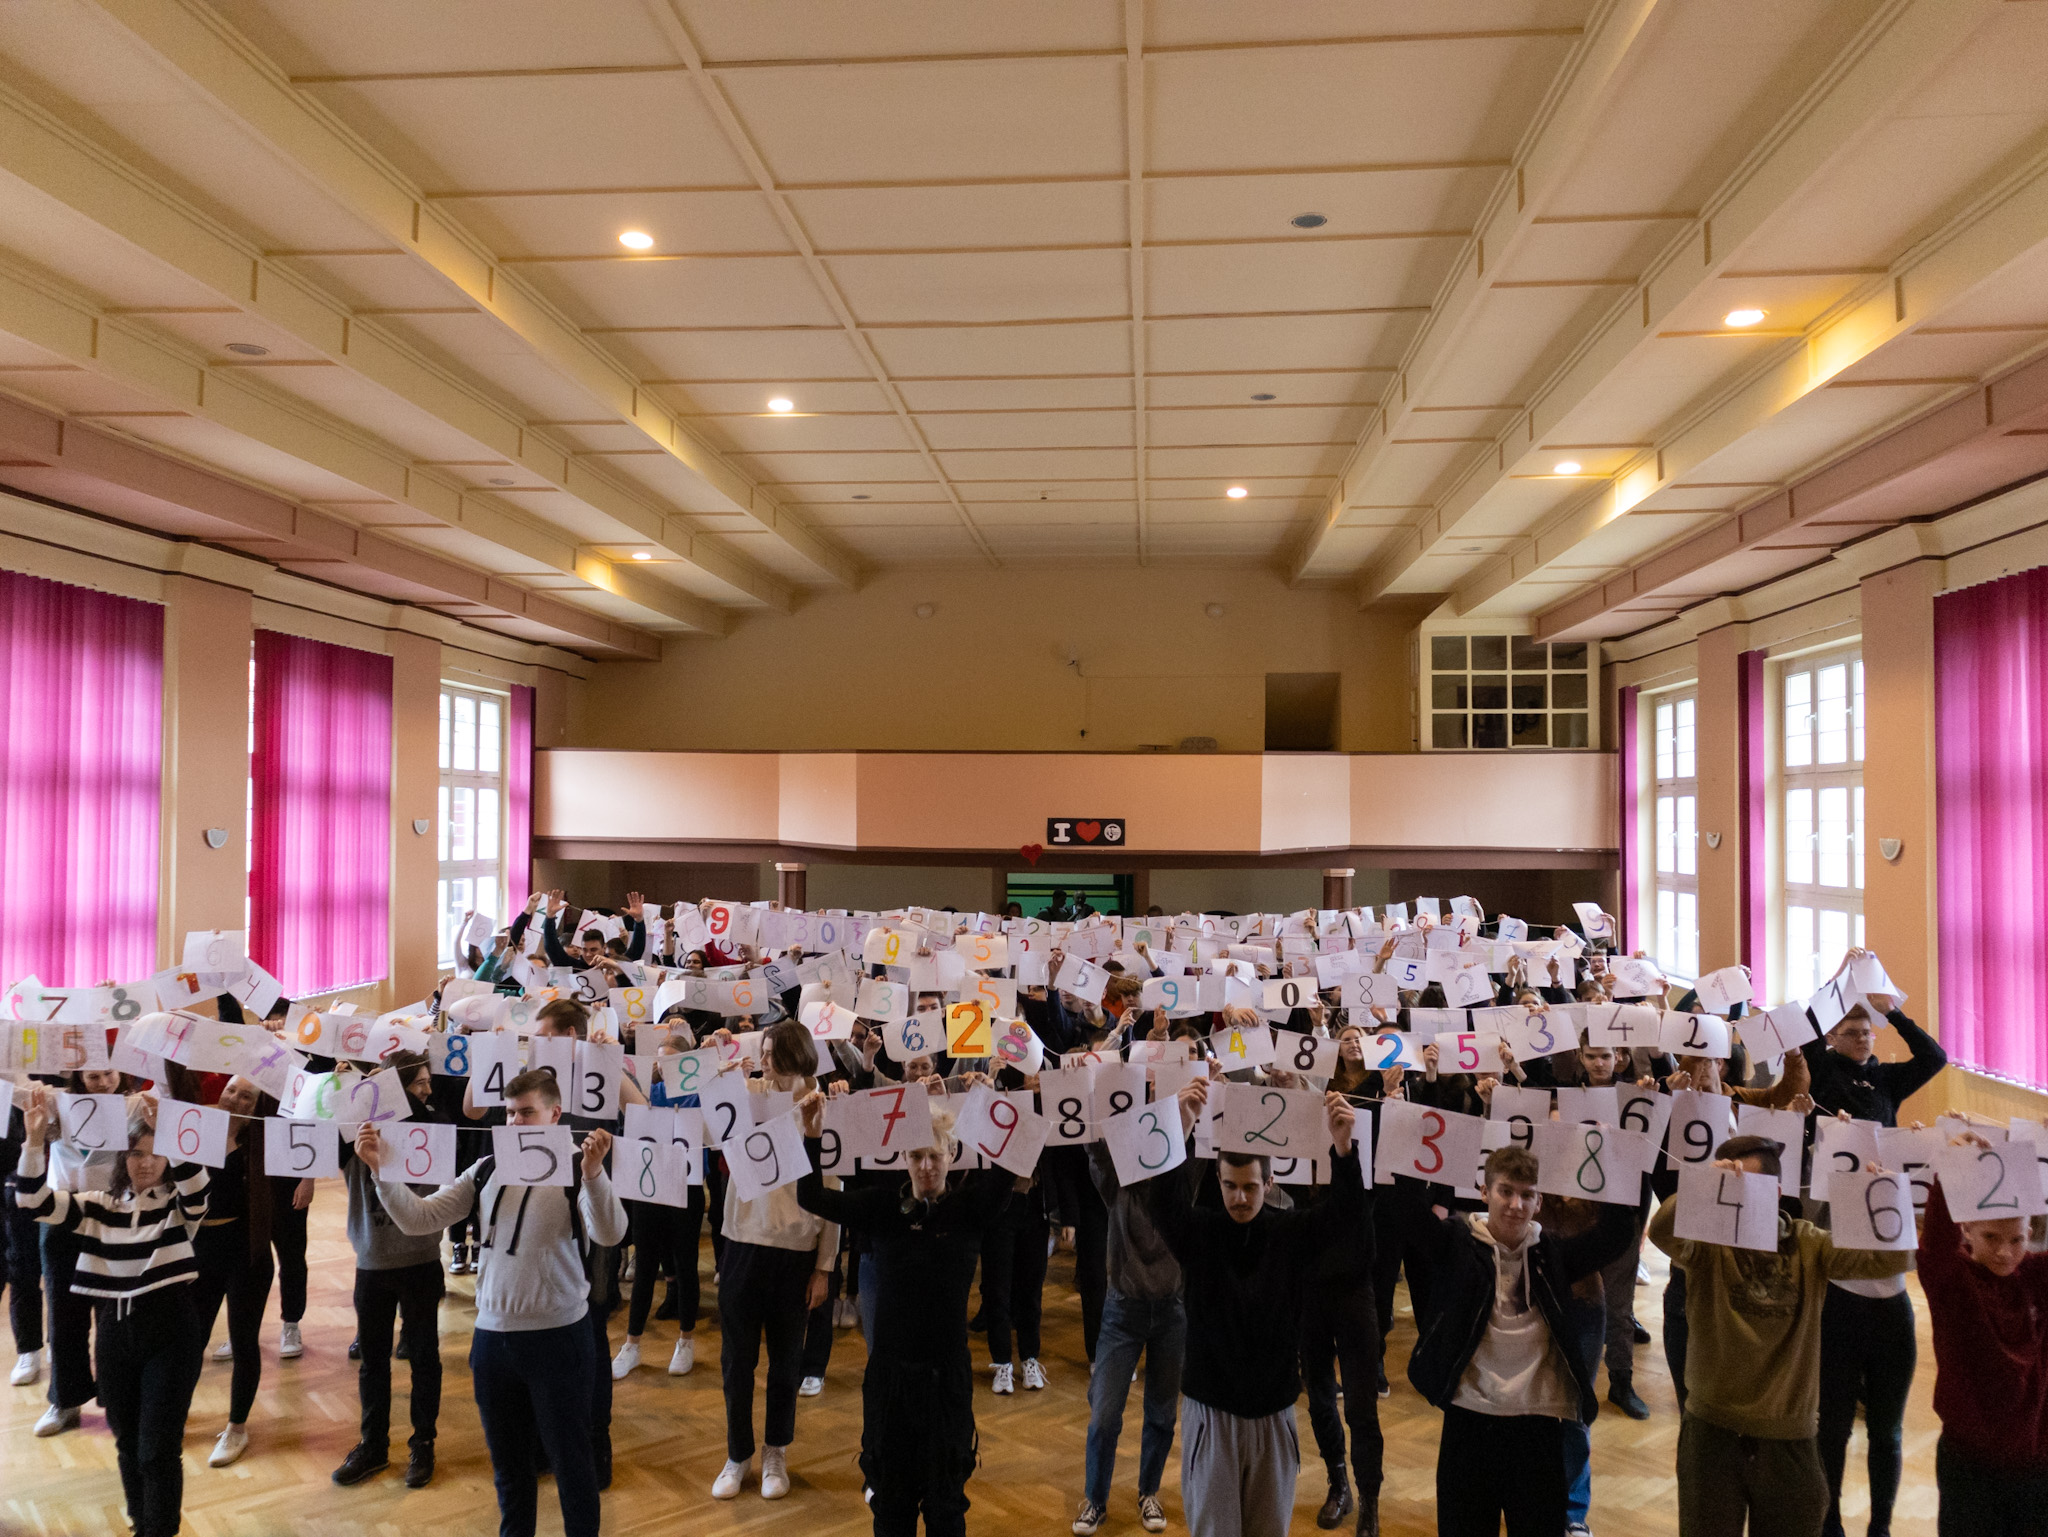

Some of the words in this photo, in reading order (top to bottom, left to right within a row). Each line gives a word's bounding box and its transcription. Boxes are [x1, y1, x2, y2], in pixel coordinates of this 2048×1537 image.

[1053, 822, 1071, 842] I
[710, 907, 729, 934] 9
[793, 916, 808, 942] 3
[821, 921, 835, 944] 0
[1229, 920, 1240, 936] 9
[1252, 920, 1263, 936] 1
[206, 938, 223, 967] 6
[882, 933, 900, 964] 9
[973, 937, 991, 961] 5
[1081, 931, 1099, 954] 7
[1187, 937, 1198, 964] 1
[1072, 961, 1095, 988] 5
[1297, 956, 1311, 975] 3
[1403, 964, 1417, 981] 5
[1624, 962, 1649, 995] 3
[111, 988, 141, 1021] 8
[244, 974, 260, 1002] 4
[576, 975, 596, 999] 8
[623, 988, 646, 1018] 8
[692, 980, 707, 1005] 8
[732, 981, 753, 1008] 6
[873, 986, 893, 1014] 3
[978, 980, 1000, 1010] 5
[1161, 981, 1178, 1010] 9
[1281, 982, 1300, 1007] 0
[1358, 975, 1373, 1005] 8
[1455, 972, 1479, 1003] 2
[1710, 972, 1729, 1002] 1
[1830, 979, 1845, 1015] 1
[38, 995, 69, 1021] 7
[814, 1002, 835, 1035] 8
[1608, 1005, 1634, 1041] 4
[297, 1012, 321, 1045] 0
[341, 1023, 367, 1053] 6
[952, 1003, 984, 1053] 2
[996, 1020, 1032, 1063] 8
[1229, 1031, 1246, 1059] 4
[1526, 1013, 1554, 1053] 3
[1683, 1016, 1708, 1049] 2
[1763, 1012, 1784, 1049] 1
[62, 1031, 88, 1069] 5
[250, 1041, 286, 1077] 7
[378, 1035, 401, 1061] 2
[444, 1035, 469, 1076] 8
[1294, 1035, 1318, 1070] 8
[1376, 1033, 1412, 1069] 2
[1457, 1034, 1479, 1069] 5
[483, 1061, 505, 1101] 4
[582, 1072, 605, 1112] 3
[351, 1080, 396, 1122] 2
[869, 1087, 906, 1147] 7
[1058, 1097, 1085, 1138] 8
[1244, 1091, 1289, 1146] 2
[1619, 1096, 1655, 1133] 6
[69, 1097, 106, 1149] 2
[177, 1108, 201, 1156] 6
[715, 1101, 737, 1142] 2
[977, 1099, 1018, 1159] 9
[1508, 1114, 1533, 1150] 9
[290, 1123, 316, 1171] 5
[405, 1128, 432, 1178] 3
[518, 1131, 558, 1183] 5
[820, 1128, 841, 1170] 9
[1138, 1112, 1170, 1169] 3
[1413, 1110, 1446, 1174] 3
[1683, 1119, 1713, 1163] 9
[639, 1146, 656, 1198] 8
[744, 1131, 780, 1187] 9
[1576, 1129, 1606, 1193] 8
[1902, 1162, 1935, 1208] 5
[1977, 1151, 2018, 1210] 2
[1716, 1173, 1744, 1244] 4
[1864, 1176, 1903, 1243] 6
